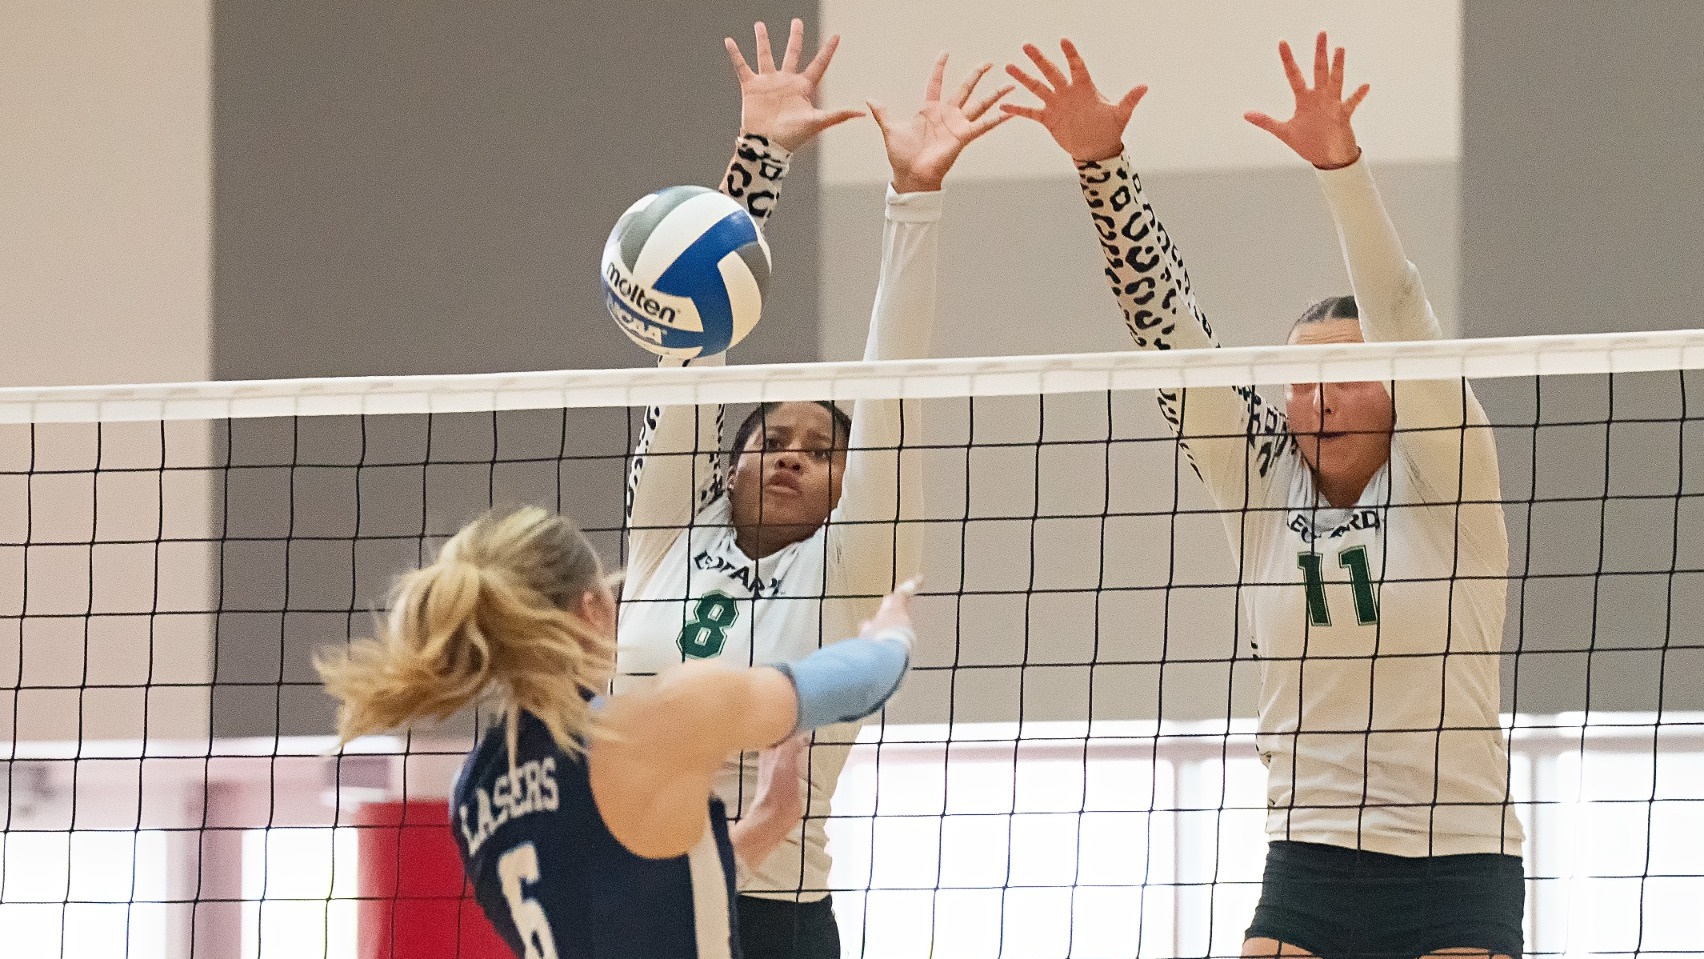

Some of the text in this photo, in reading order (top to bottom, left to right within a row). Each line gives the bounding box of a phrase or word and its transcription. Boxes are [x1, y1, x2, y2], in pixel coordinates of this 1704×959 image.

[607, 262, 676, 323] molten
[676, 589, 739, 659] 8
[1297, 545, 1379, 626] 11
[459, 757, 560, 858] LASERS
[497, 840, 561, 959] 6
